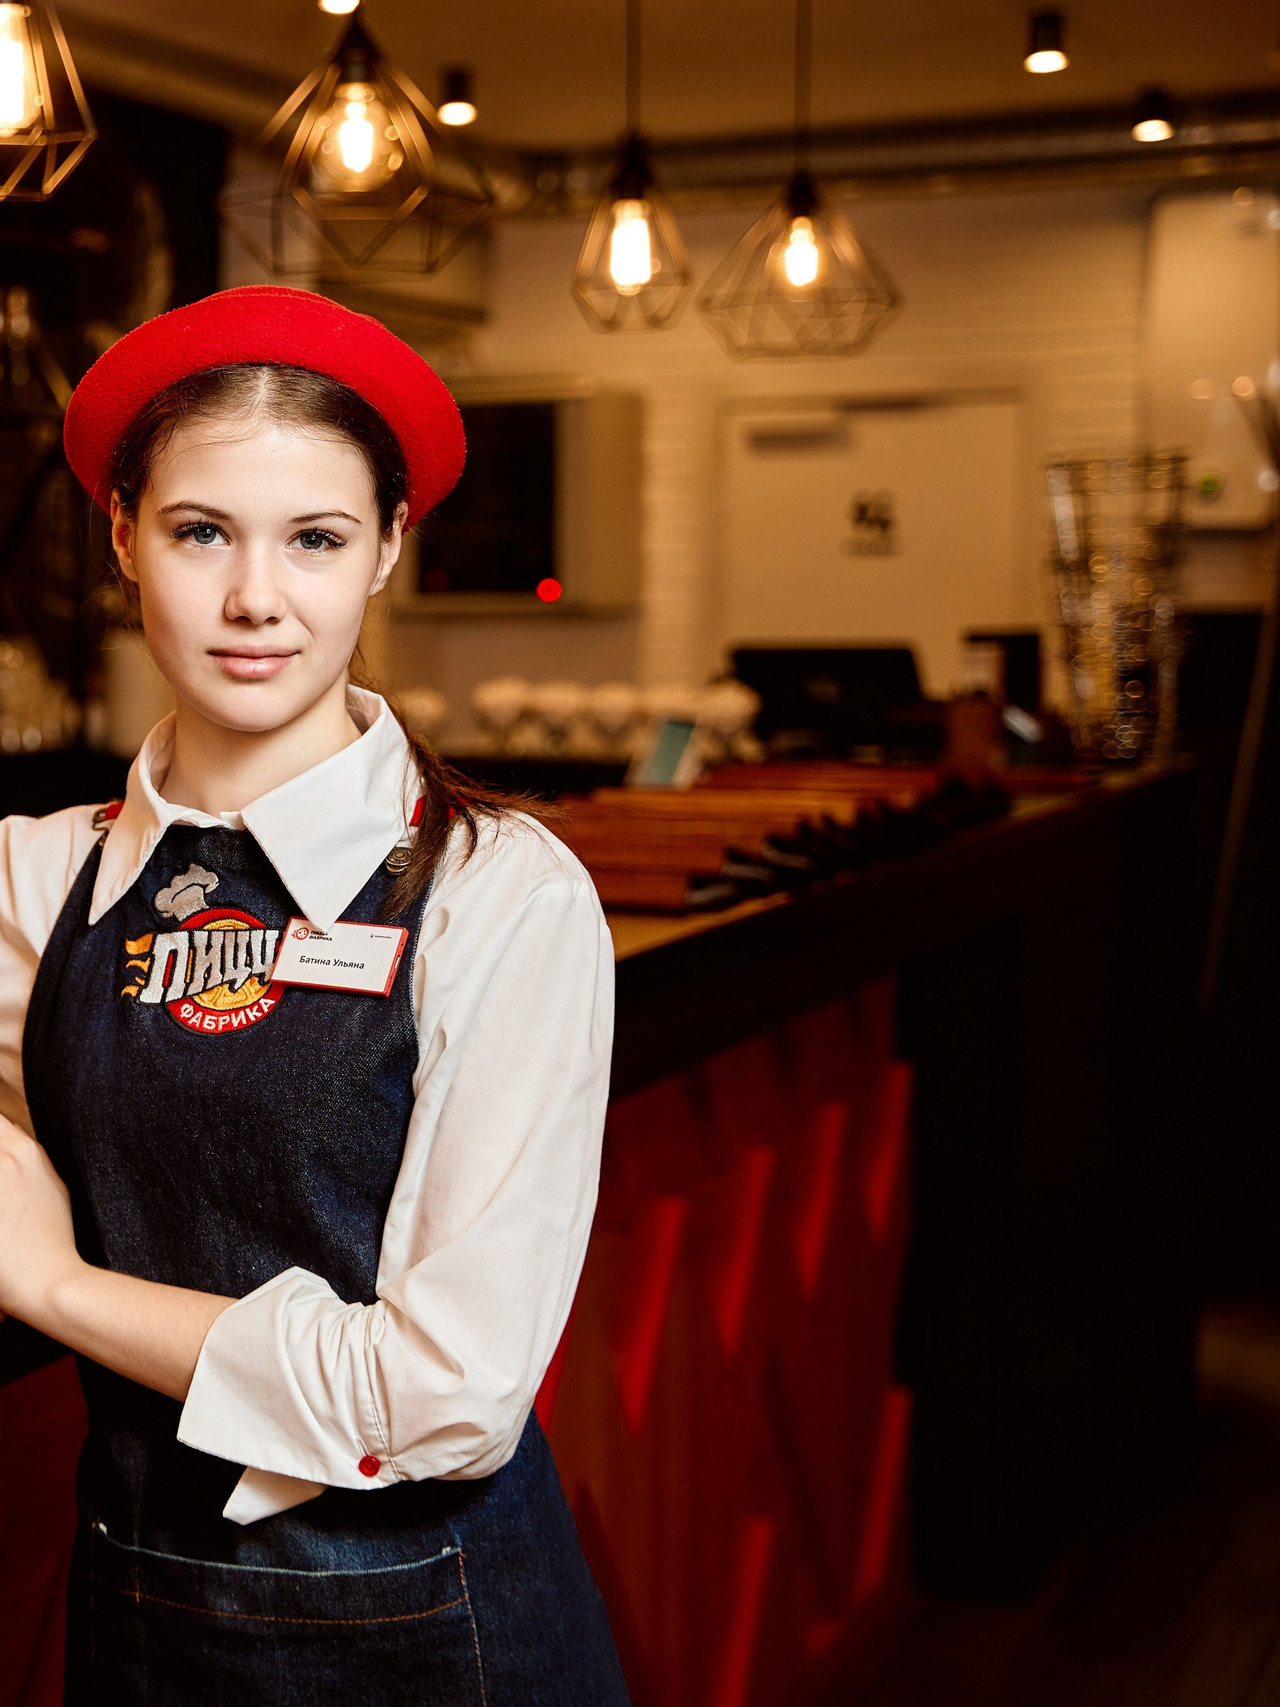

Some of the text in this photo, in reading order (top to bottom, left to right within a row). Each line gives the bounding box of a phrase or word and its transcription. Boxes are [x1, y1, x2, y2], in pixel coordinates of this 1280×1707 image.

[138, 929, 280, 1003] ПИЦЦ
[299, 955, 366, 970] Батина Ульяна
[179, 997, 276, 1031] ФАБРИКА
